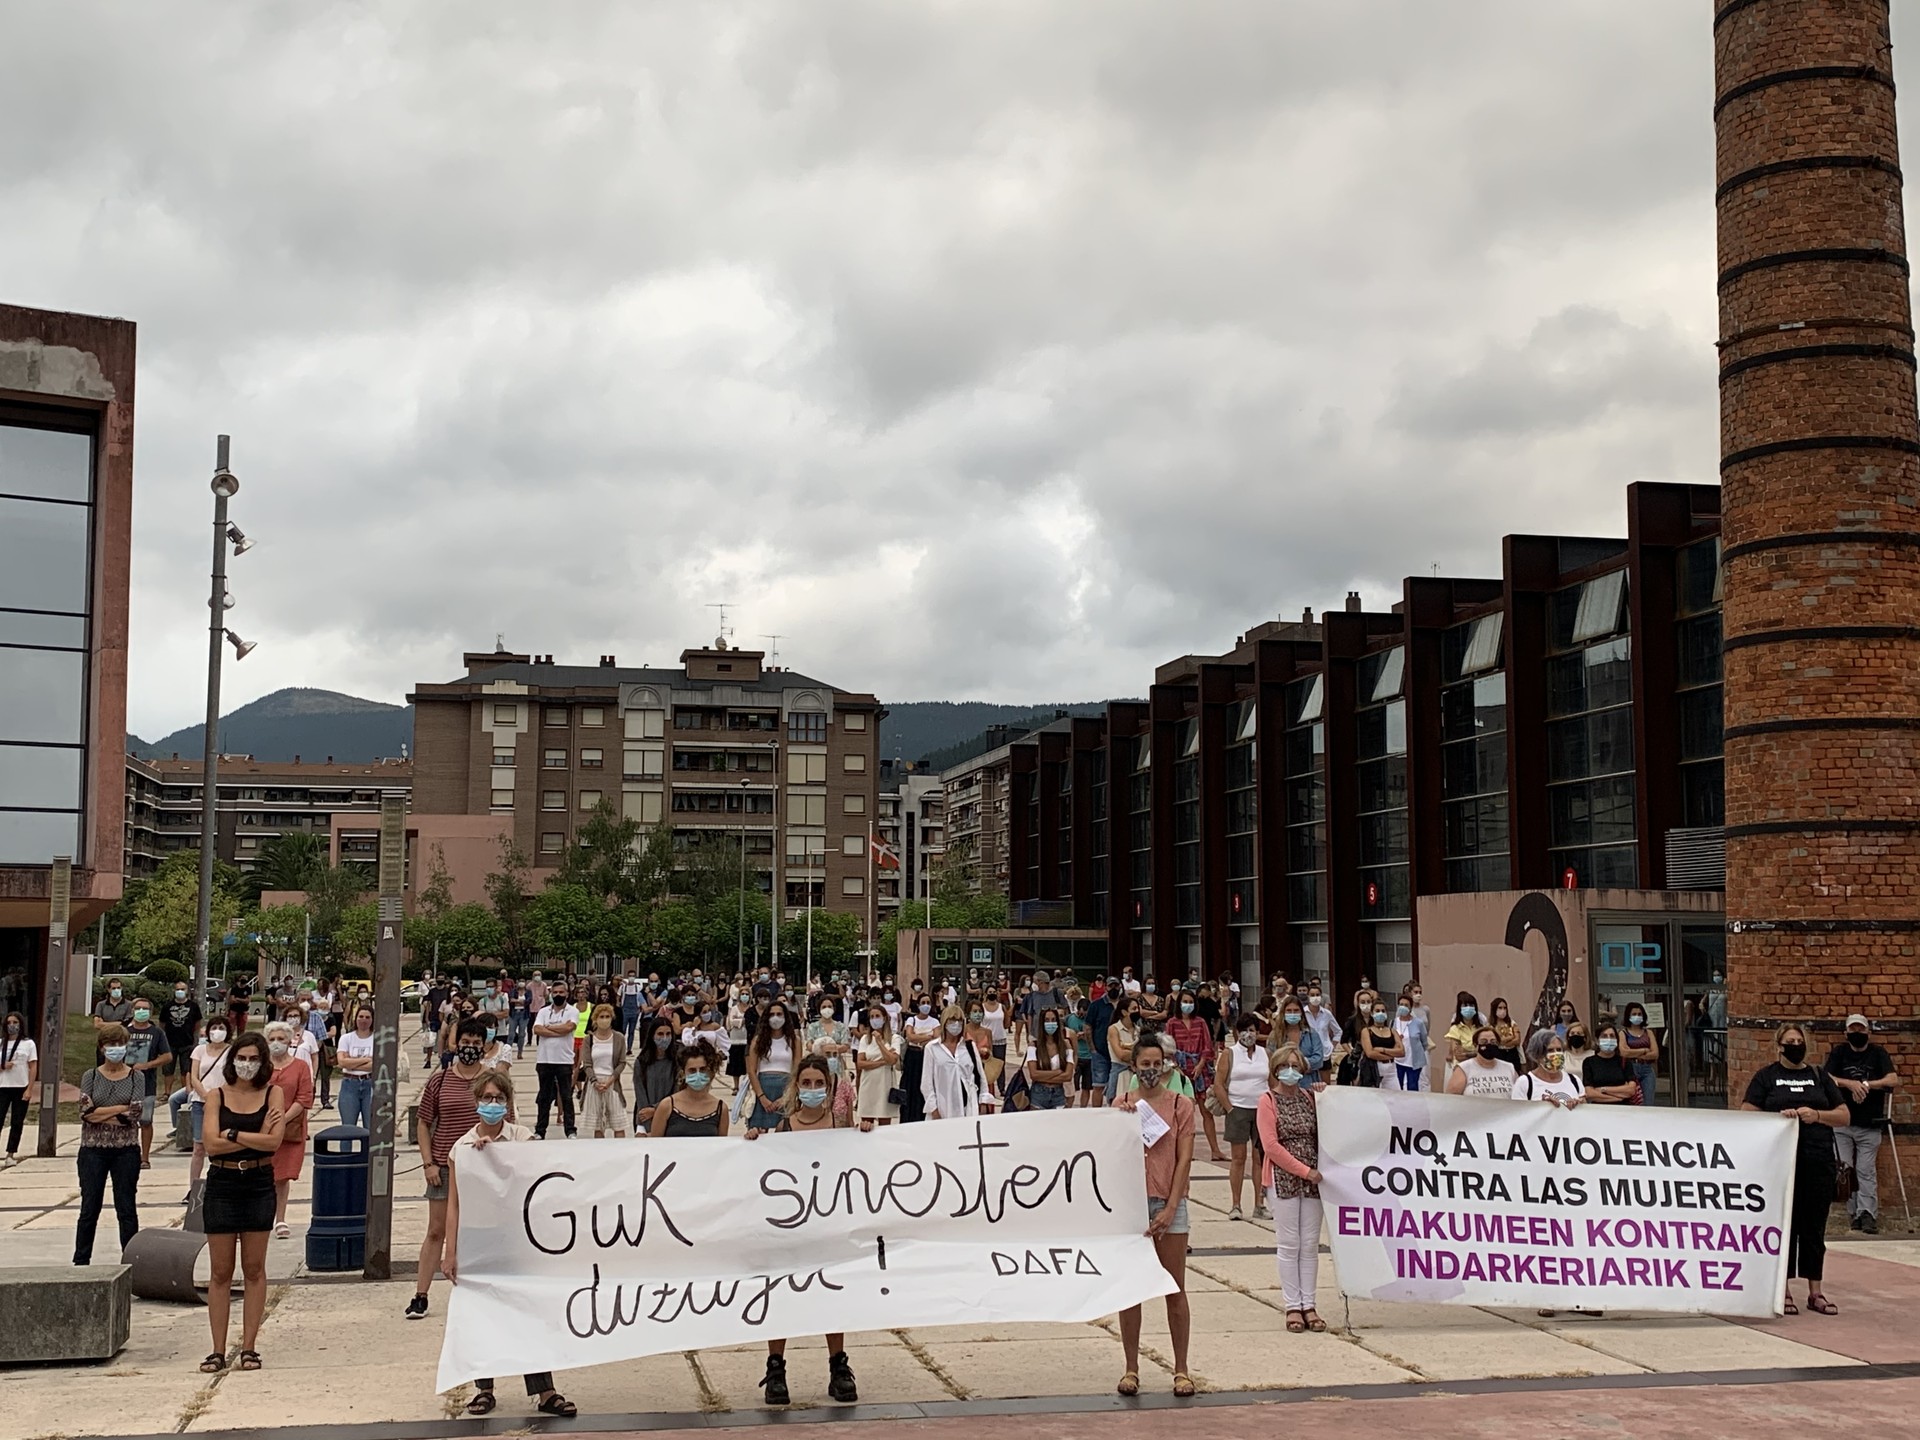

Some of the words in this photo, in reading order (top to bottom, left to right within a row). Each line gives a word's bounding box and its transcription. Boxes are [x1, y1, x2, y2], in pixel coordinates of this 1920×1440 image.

[1390, 1126, 1437, 1157] NO
[1453, 1131, 1478, 1158] A
[1486, 1132, 1531, 1162] LA
[1538, 1135, 1736, 1170] VIOLENCIA
[758, 1120, 1113, 1229] sinesten
[1361, 1165, 1511, 1202] CONTRA
[1520, 1175, 1589, 1206] LAS
[1599, 1178, 1767, 1213] MUJERES
[1338, 1206, 1574, 1248] EMAKUMEEN
[1586, 1218, 1782, 1256] KONTRAKO
[1396, 1248, 1691, 1288] INDARKERIARIK
[1700, 1260, 1744, 1292] EZ
